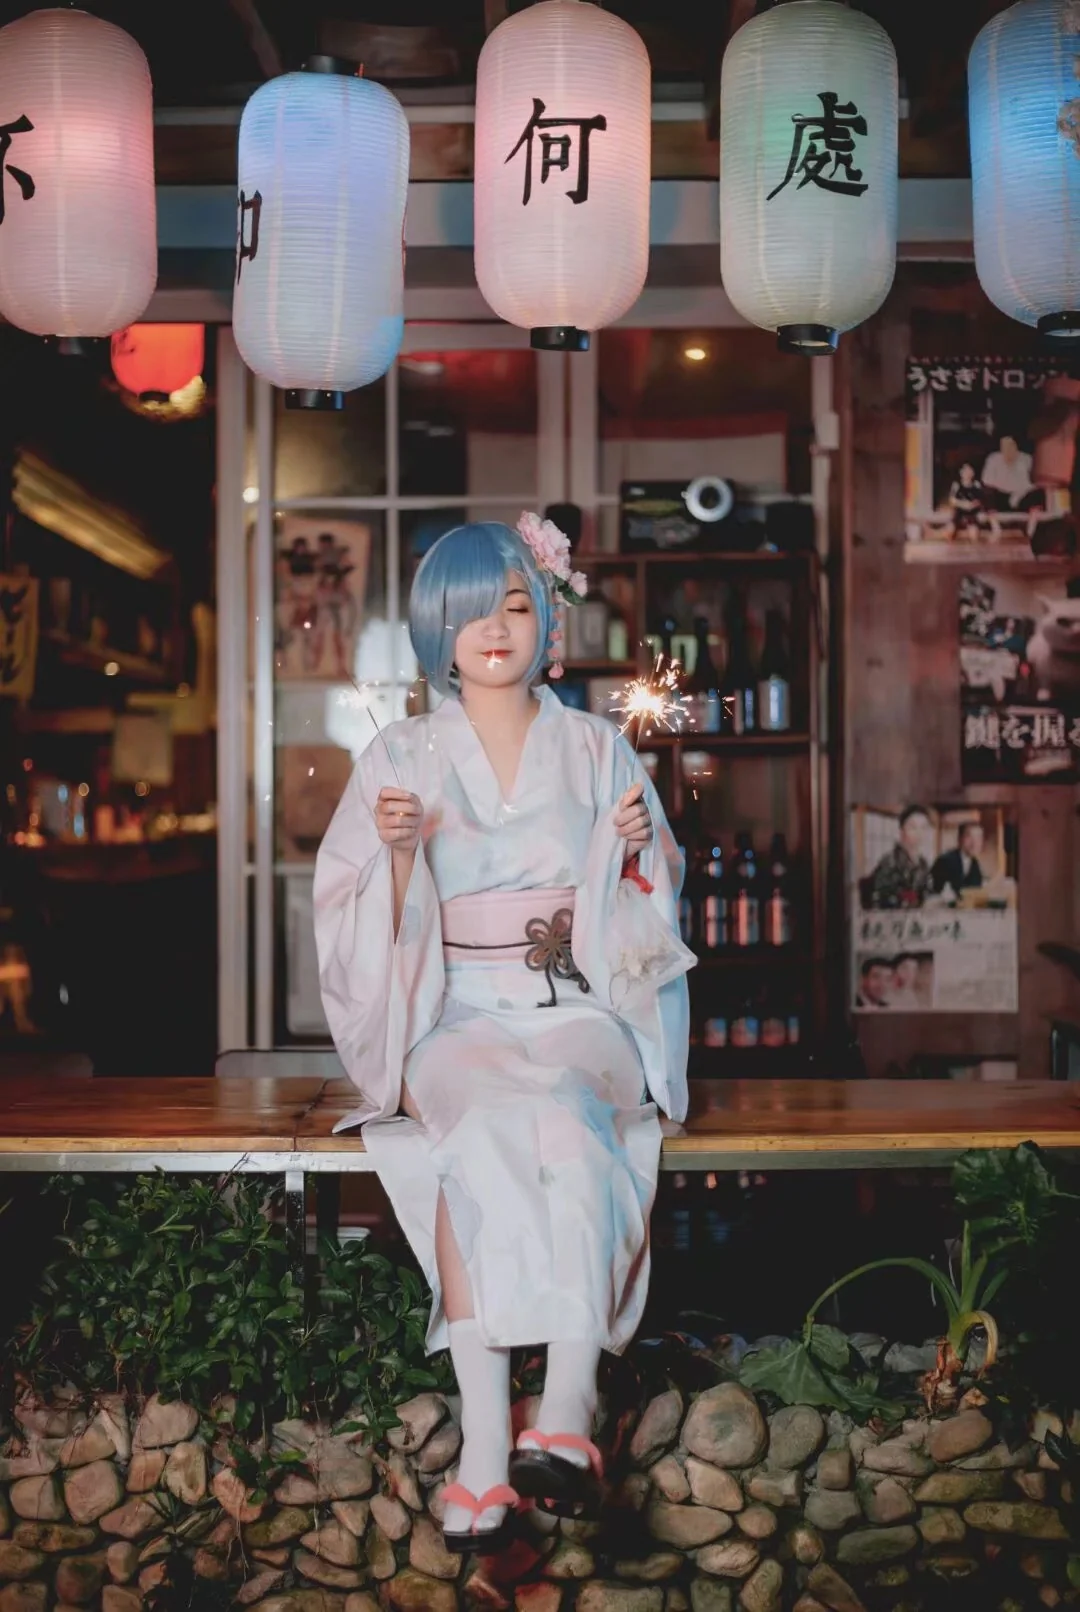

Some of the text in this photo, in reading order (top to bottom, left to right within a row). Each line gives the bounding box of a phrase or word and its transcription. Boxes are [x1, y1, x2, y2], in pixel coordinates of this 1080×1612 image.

[504, 98, 606, 206] 何
[766, 92, 869, 201] 處
[907, 366, 1060, 391] うさぎドロッ
